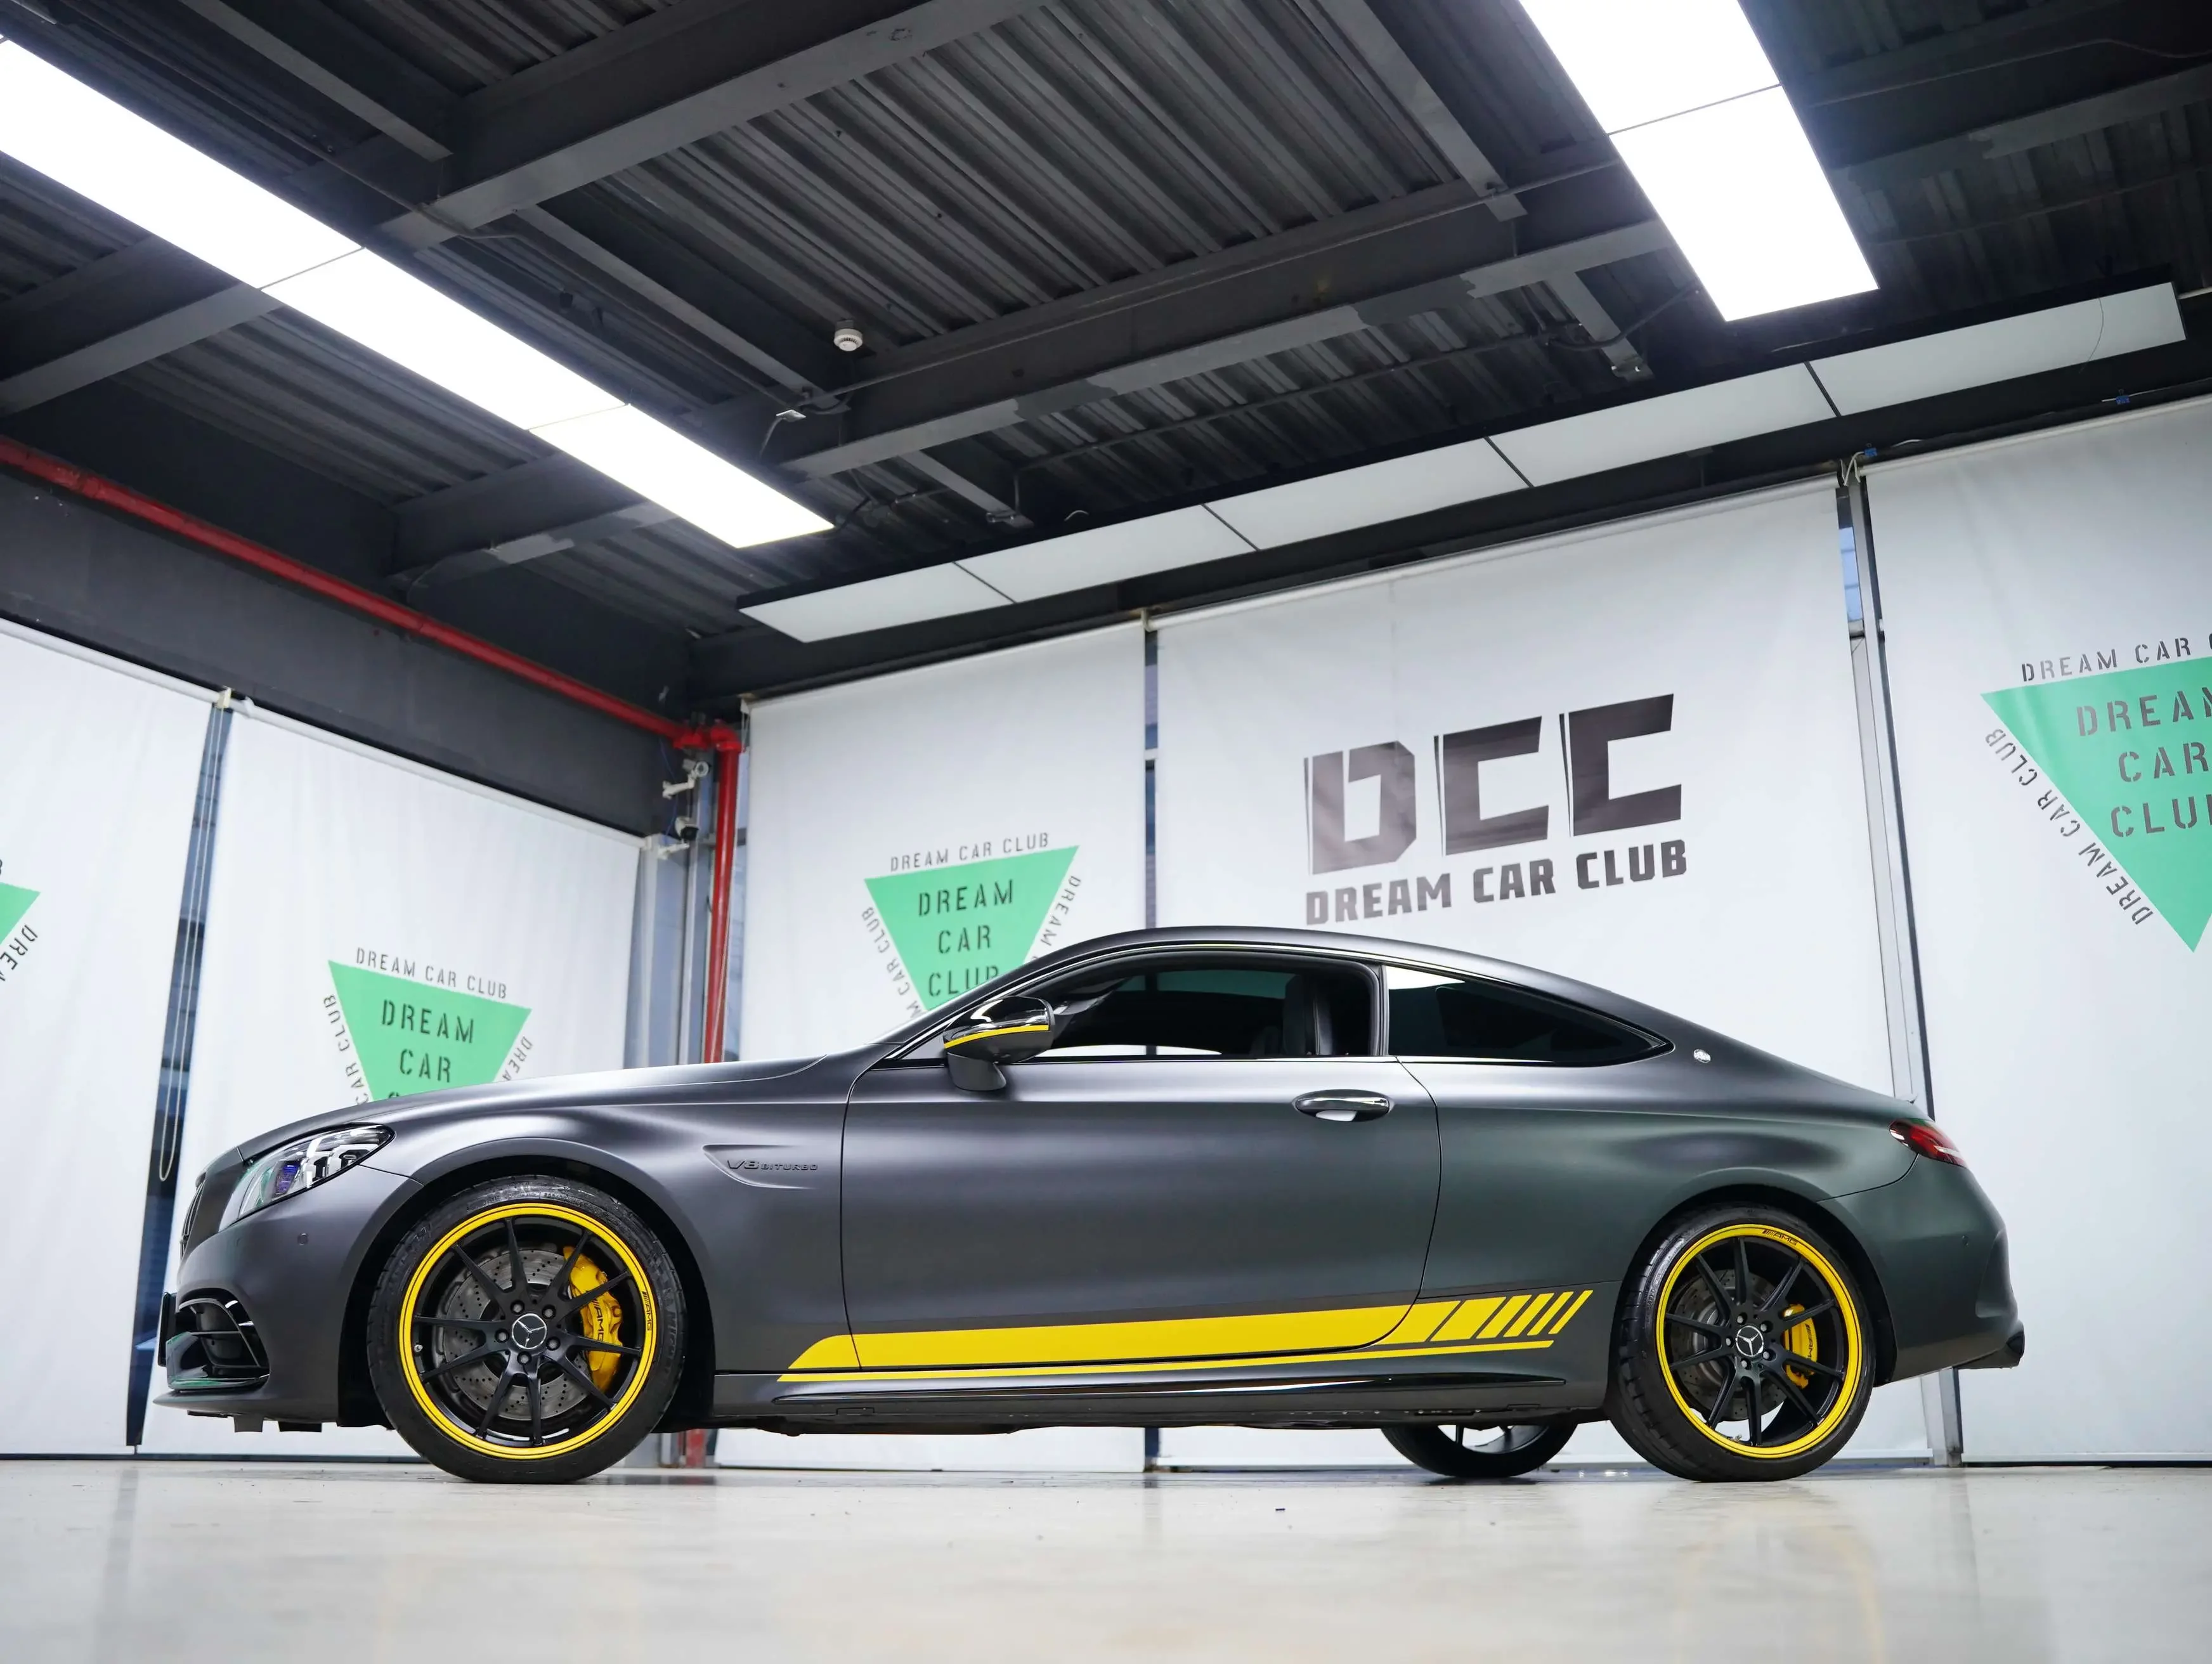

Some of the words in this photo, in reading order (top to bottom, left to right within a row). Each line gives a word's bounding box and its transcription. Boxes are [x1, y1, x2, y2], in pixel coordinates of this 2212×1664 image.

[2021, 649, 2118, 682] DREAM
[2135, 637, 2191, 664] CAR
[1985, 727, 2038, 786] CLUB
[2118, 741, 2209, 783] CAR
[1303, 693, 1682, 876] DCC
[2037, 790, 2081, 837] CAR
[2110, 794, 2212, 838] CLU
[890, 848, 949, 872] DREAM
[959, 842, 993, 861] CAR
[1003, 832, 1050, 854] CLUB
[918, 879, 1013, 916] DREAM
[1306, 873, 1452, 926] DREAM
[1472, 858, 1556, 904] CAR
[1575, 839, 1687, 890] CLUB
[2078, 842, 2154, 925] DREAM
[861, 906, 890, 954] CLUB
[1040, 875, 1081, 946] DREAM
[938, 924, 991, 954] CAR
[356, 947, 415, 977] DREAM
[425, 965, 457, 987] CAR
[467, 975, 507, 1000] CLUB
[887, 957, 911, 996] CAR
[323, 994, 350, 1052] CLUB
[382, 999, 474, 1044] DREAM
[399, 1048, 452, 1083] CAR
[727, 1159, 760, 1171] V8
